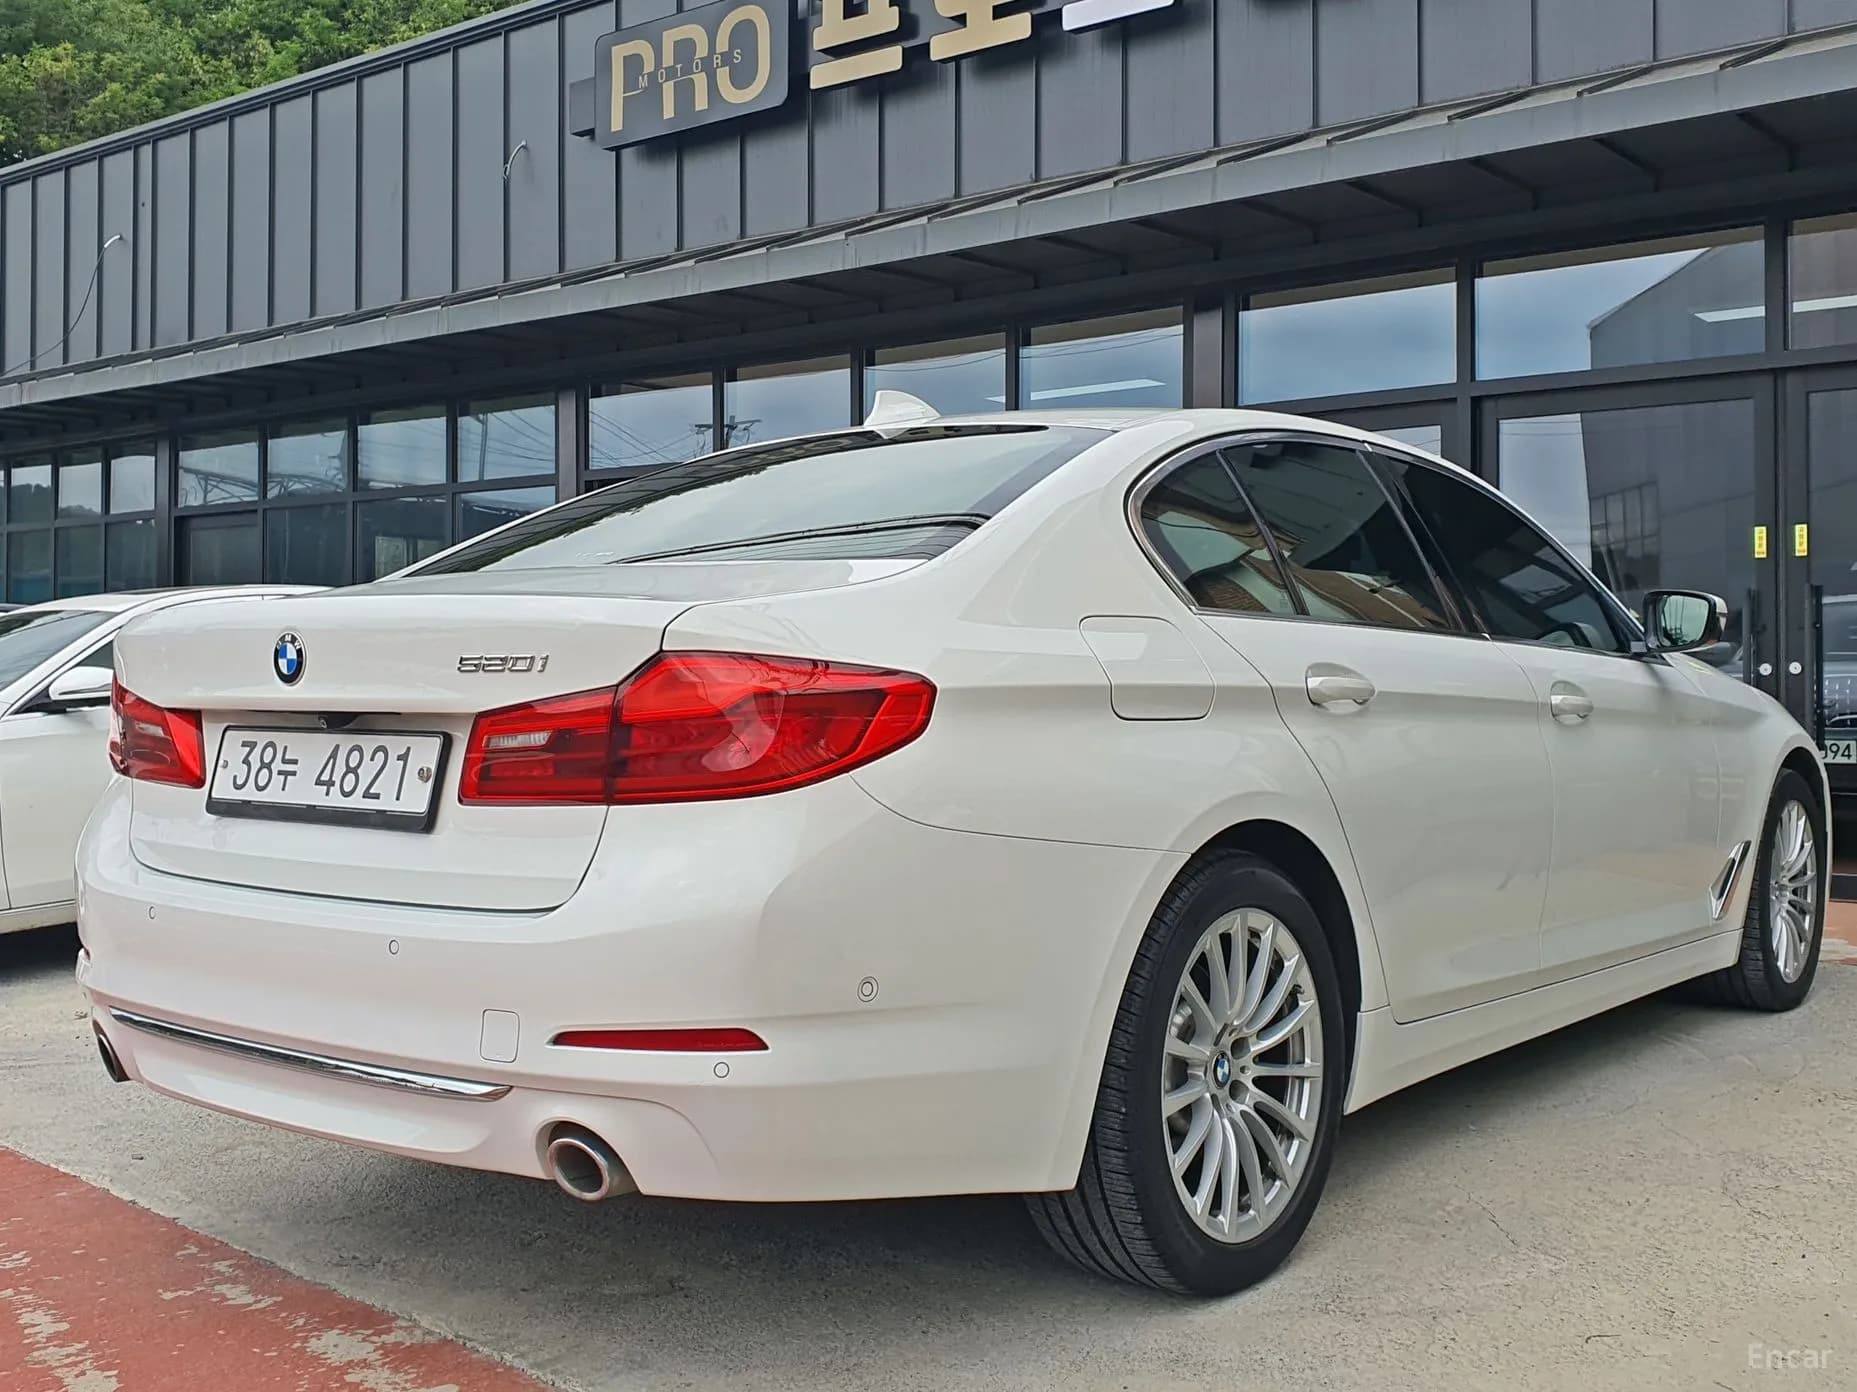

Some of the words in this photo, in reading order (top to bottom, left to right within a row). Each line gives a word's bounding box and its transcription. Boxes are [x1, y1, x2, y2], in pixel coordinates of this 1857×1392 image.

[610, 4, 771, 133] PRO
[638, 49, 742, 89] MOTORS
[457, 654, 550, 673] 520i
[232, 740, 299, 792] 38누
[314, 743, 411, 801] 4821
